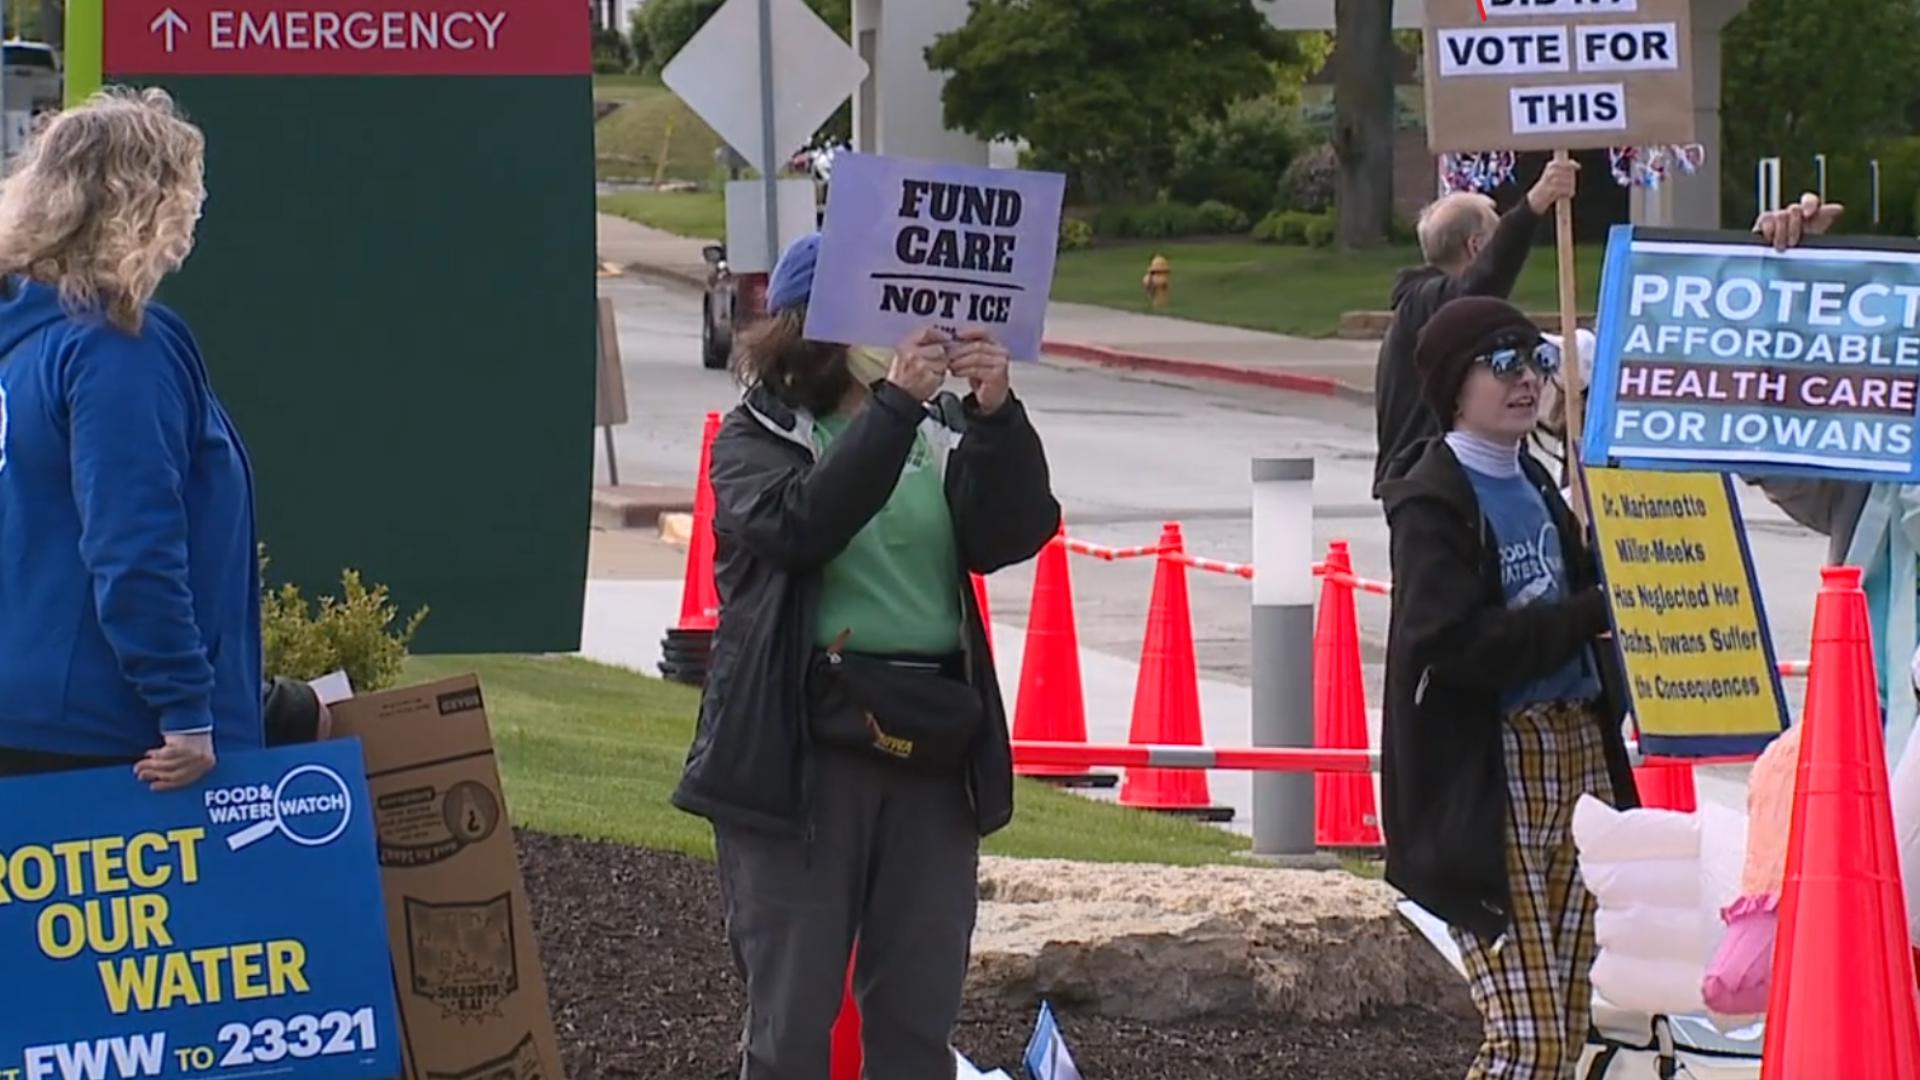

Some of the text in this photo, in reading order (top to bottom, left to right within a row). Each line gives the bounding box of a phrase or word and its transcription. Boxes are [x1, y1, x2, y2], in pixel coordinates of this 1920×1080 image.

[210, 10, 506, 49] EMERGENCY
[1447, 31, 1669, 66] VOTE FOR
[1519, 92, 1618, 124] THIS
[898, 179, 1022, 228] FUND
[895, 225, 1016, 273] CARE
[879, 284, 1012, 323] NOT ICE
[1629, 274, 1920, 328] PROTECT
[1623, 324, 1920, 366] AFFORDABLE
[1619, 367, 1915, 410] HEALTH CARE
[1615, 410, 1912, 454] FOR IOWANS
[1501, 559, 1542, 584] ATER
[1637, 582, 1709, 615] Neglected
[1713, 583, 1739, 606] Her
[1709, 625, 1758, 650] Suffer
[1655, 675, 1760, 703] Consequences
[204, 784, 273, 807] FOOD&
[209, 803, 273, 824] WATER
[279, 793, 345, 816] WATCH
[37, 893, 173, 959] OUR
[98, 939, 310, 1014] WATER
[437, 984, 499, 998] ELECTRIC
[24, 1007, 376, 1080] FWW TO 23321
